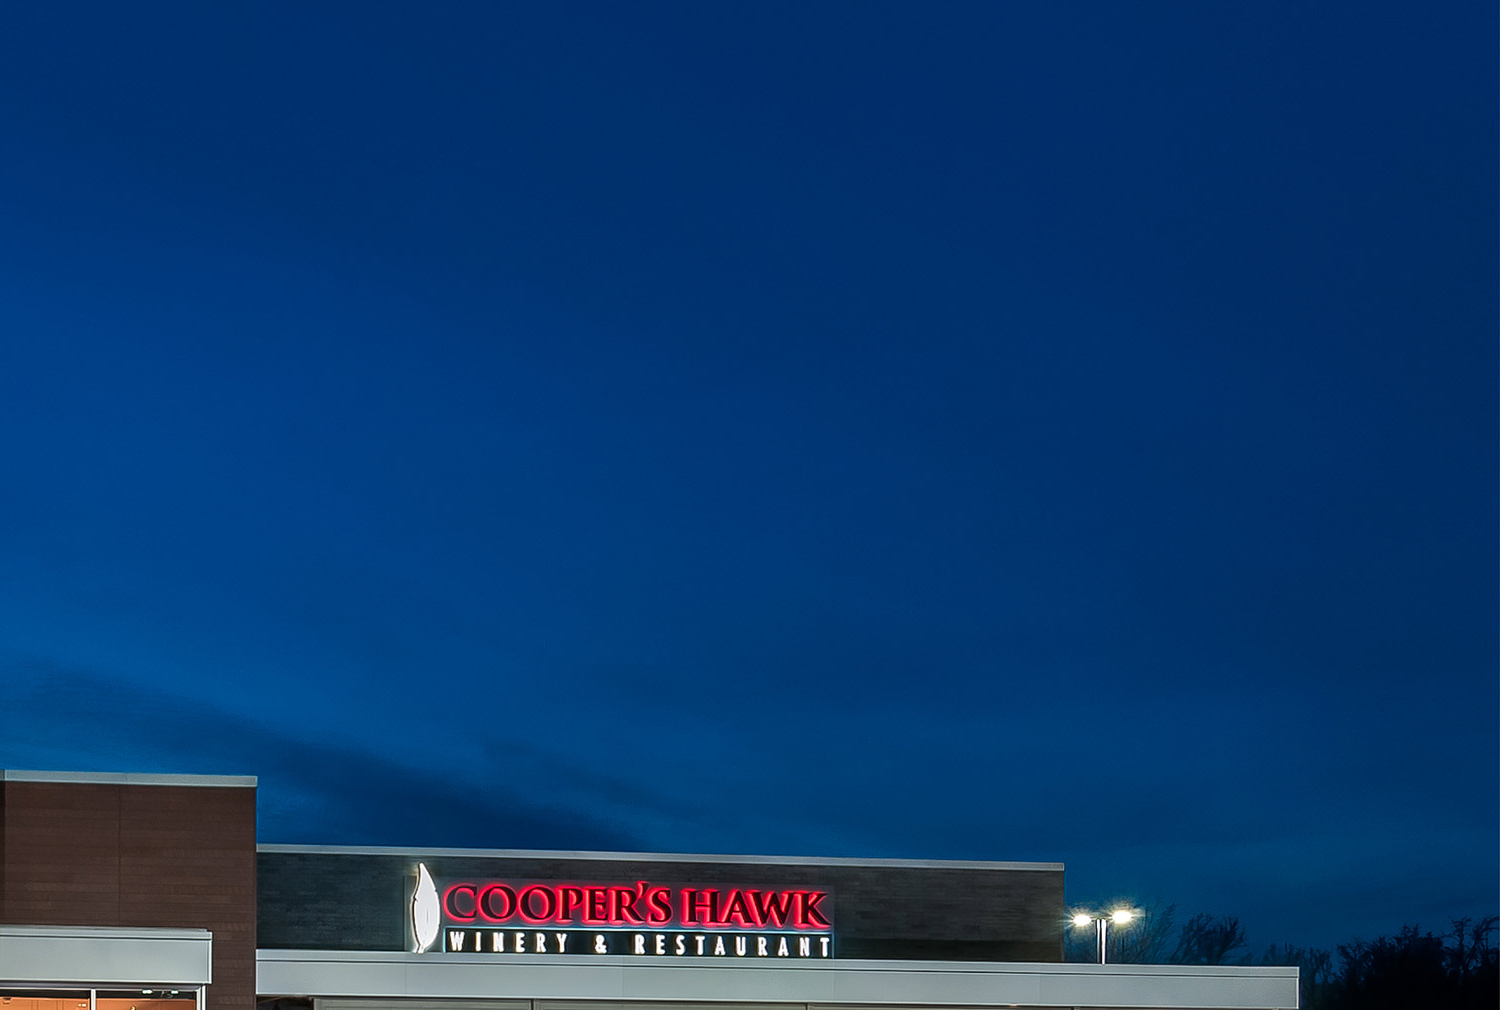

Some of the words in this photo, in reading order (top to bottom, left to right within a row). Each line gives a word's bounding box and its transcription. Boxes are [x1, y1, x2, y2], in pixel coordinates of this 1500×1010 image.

[443, 880, 672, 926] COOPER'S
[681, 888, 832, 930] HAWK
[449, 930, 568, 954] WINERY
[594, 933, 609, 955] &
[634, 933, 832, 958] RESTAURANT
